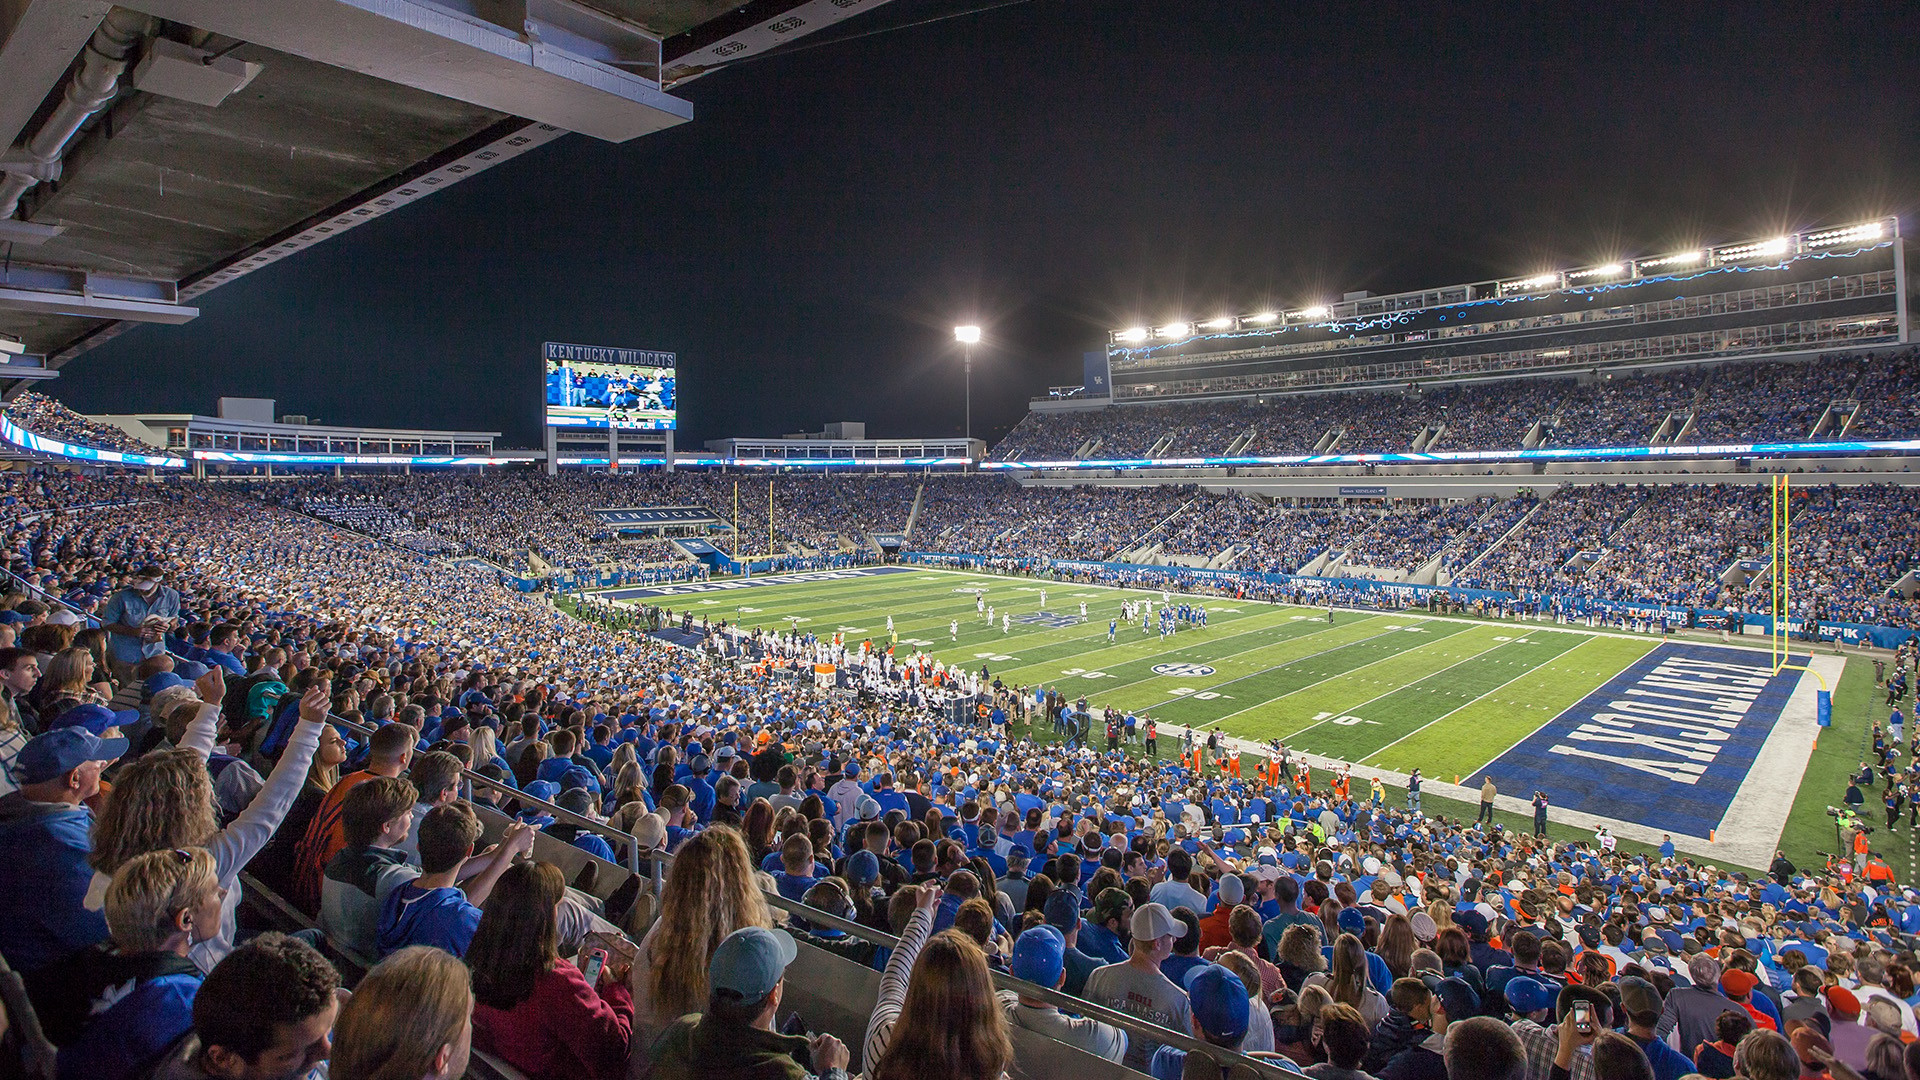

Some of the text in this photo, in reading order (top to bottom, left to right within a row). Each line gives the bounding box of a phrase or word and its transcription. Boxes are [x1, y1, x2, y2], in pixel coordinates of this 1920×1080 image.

[549, 344, 674, 366] KENTUCKY WILDCATS
[1699, 445, 1753, 454] KENTUCKY
[599, 509, 708, 522] KENTUCKY
[646, 570, 876, 595] KENTUCKY
[1776, 621, 1859, 639] #WREUK
[1311, 711, 1363, 726] 10
[1548, 656, 1776, 785] KENTUCKY
